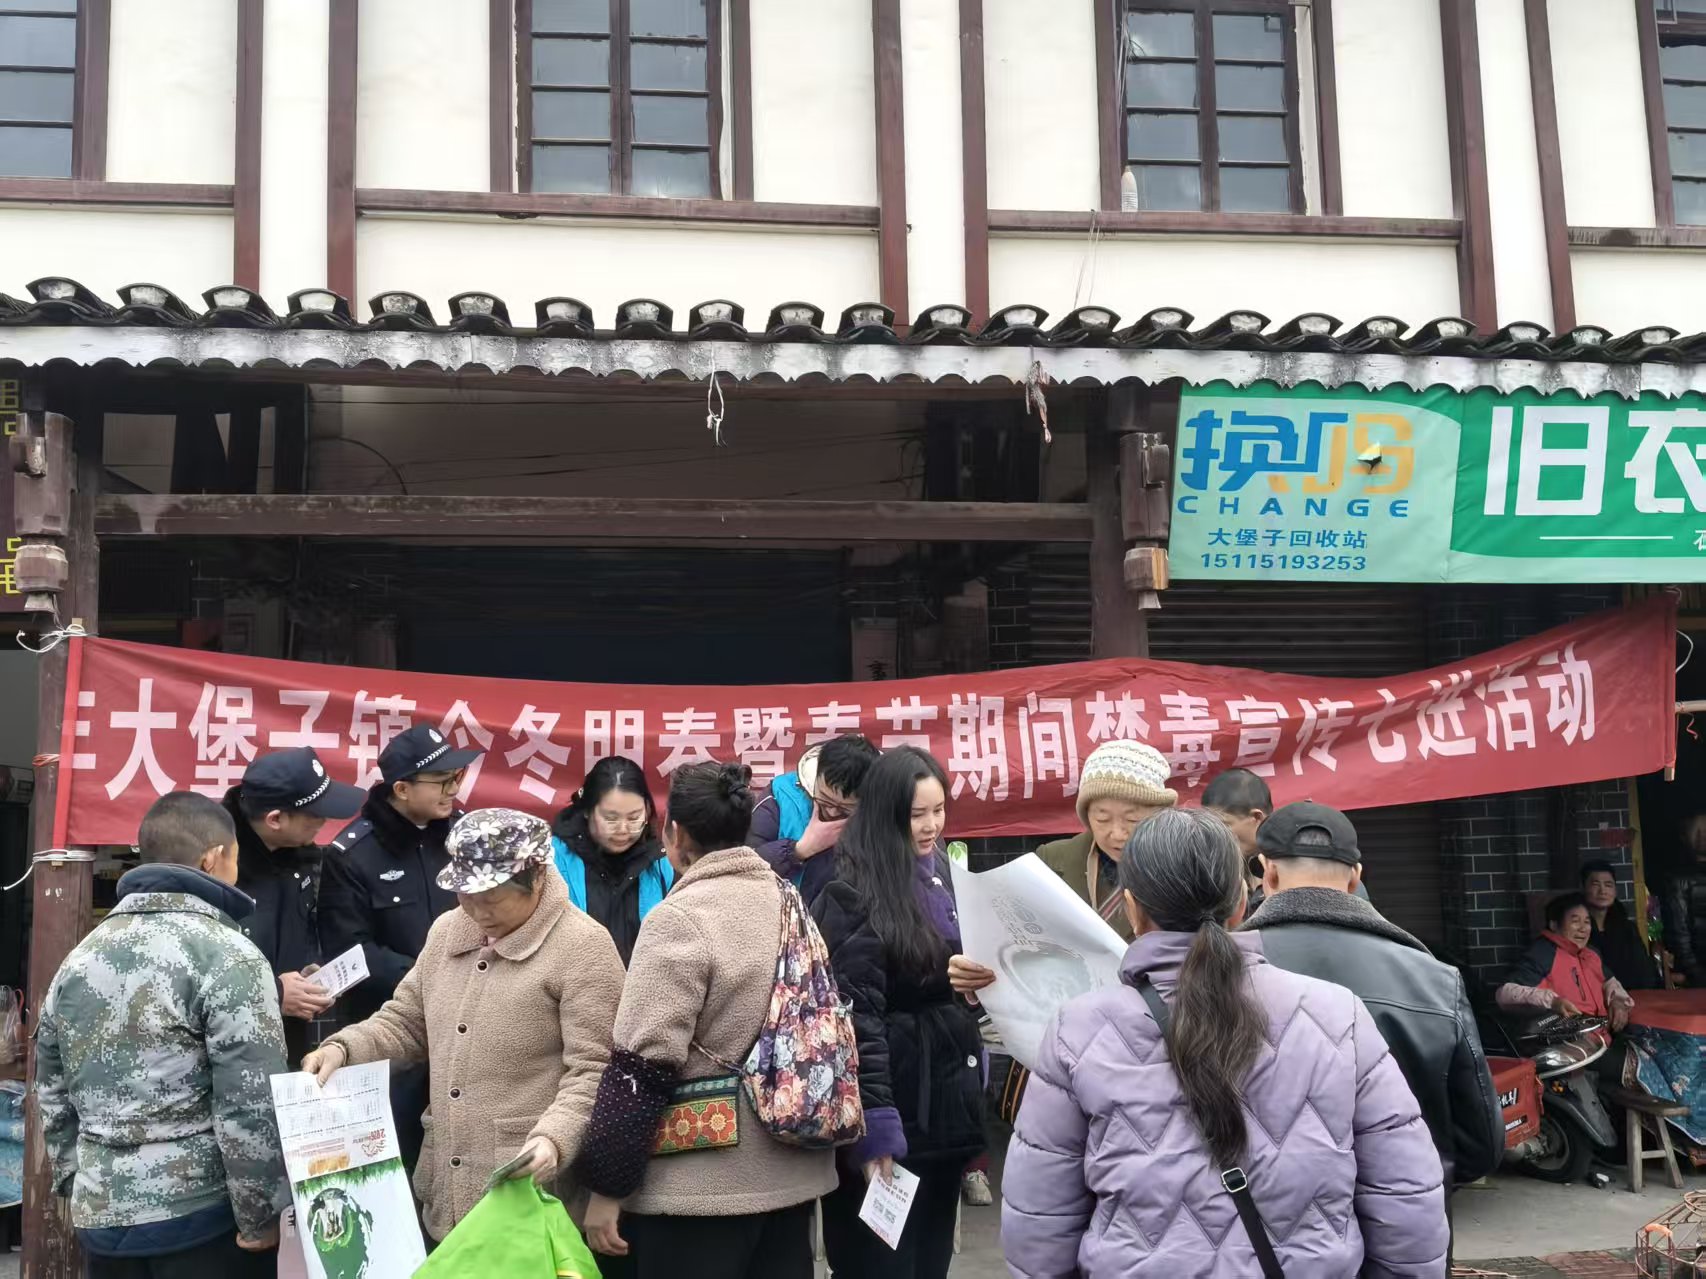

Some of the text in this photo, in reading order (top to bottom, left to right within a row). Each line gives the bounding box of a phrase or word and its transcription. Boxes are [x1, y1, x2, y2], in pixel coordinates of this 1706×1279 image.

[1177, 495, 1409, 518] CHANGE
[1207, 527, 1367, 549] 大堡子回收站
[1201, 553, 1367, 571] 15115193253
